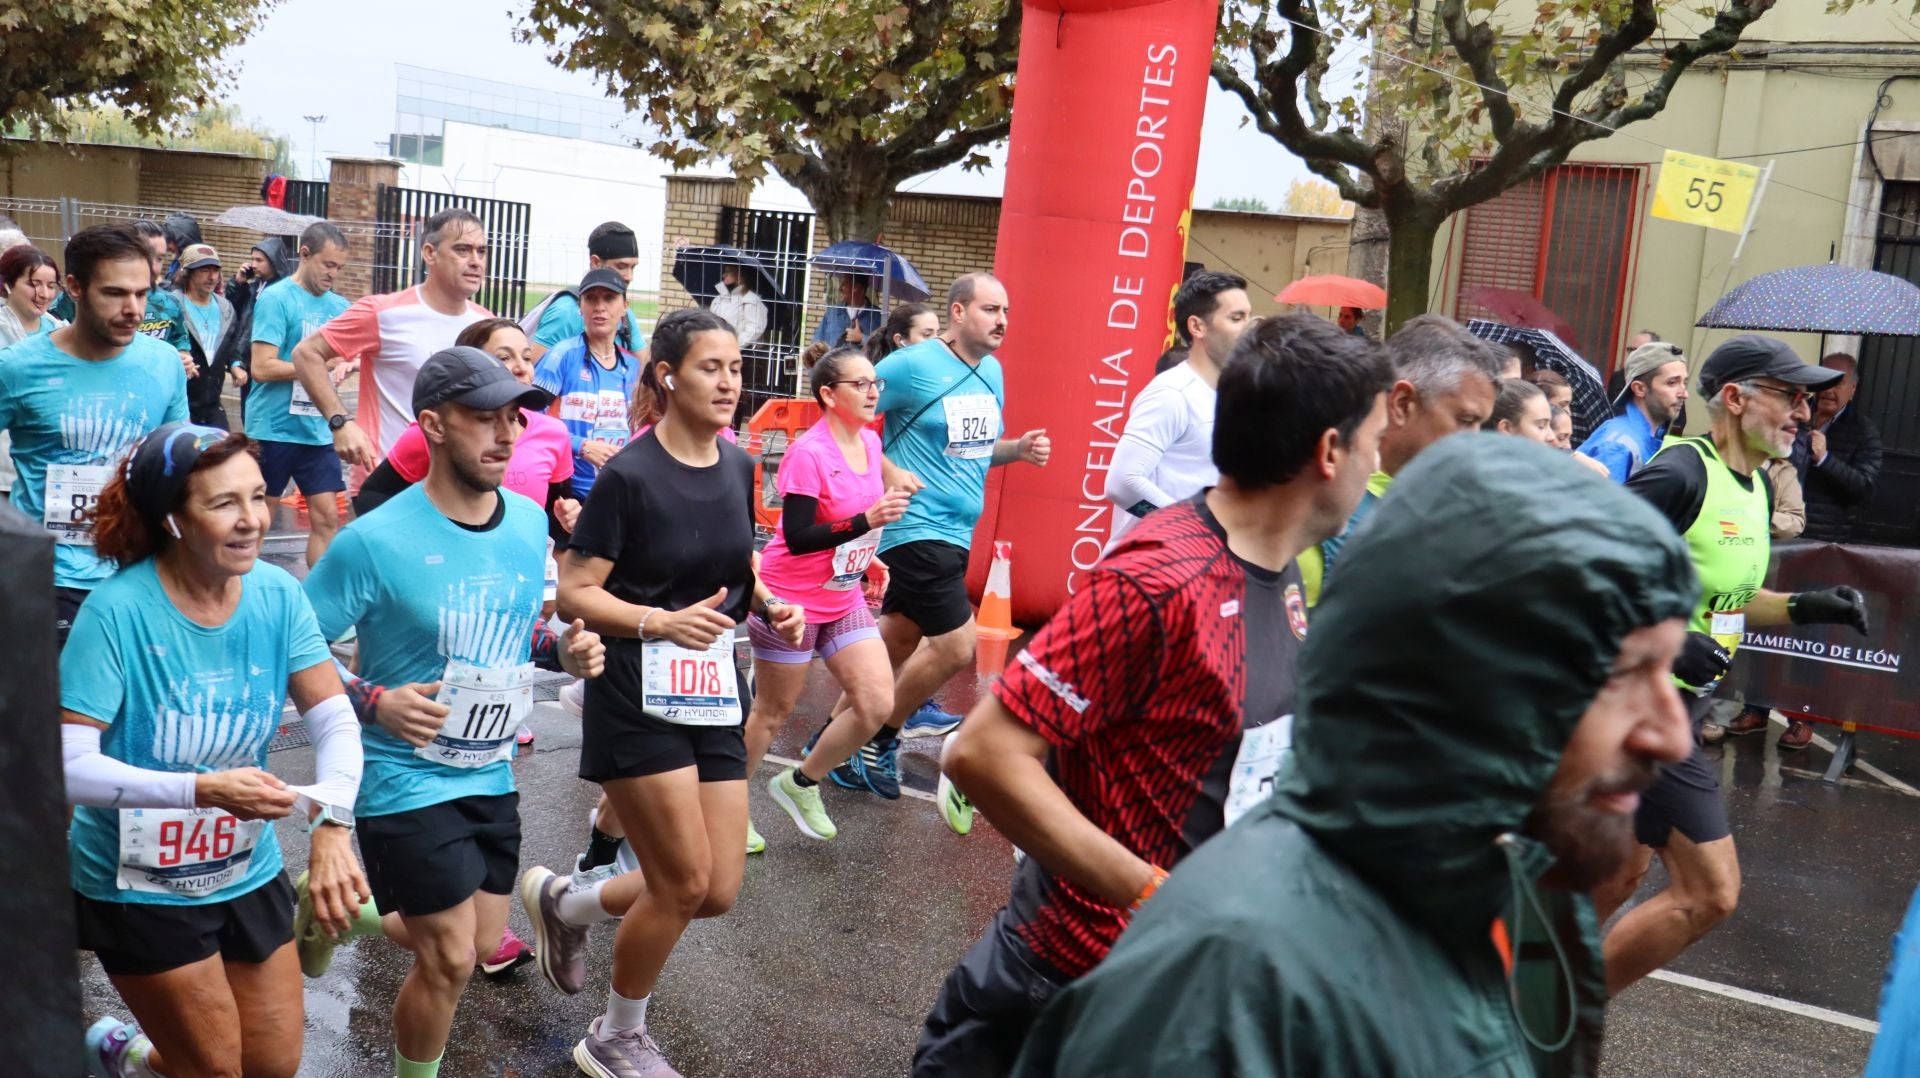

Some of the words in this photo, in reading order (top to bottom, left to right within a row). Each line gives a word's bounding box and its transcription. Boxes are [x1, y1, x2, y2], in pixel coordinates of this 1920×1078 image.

[1118, 44, 1177, 258] DEPORTES
[1685, 177, 1726, 213] 55
[1107, 275, 1144, 330] DE
[962, 416, 988, 441] 824
[1829, 645, 1851, 660] DE
[1855, 649, 1901, 668] LEÓN
[669, 659, 721, 696] 1018
[462, 703, 512, 739] 1171
[684, 708, 728, 718] HYUNDAI
[159, 815, 237, 866] 946
[176, 869, 234, 890] HYUNDAI
